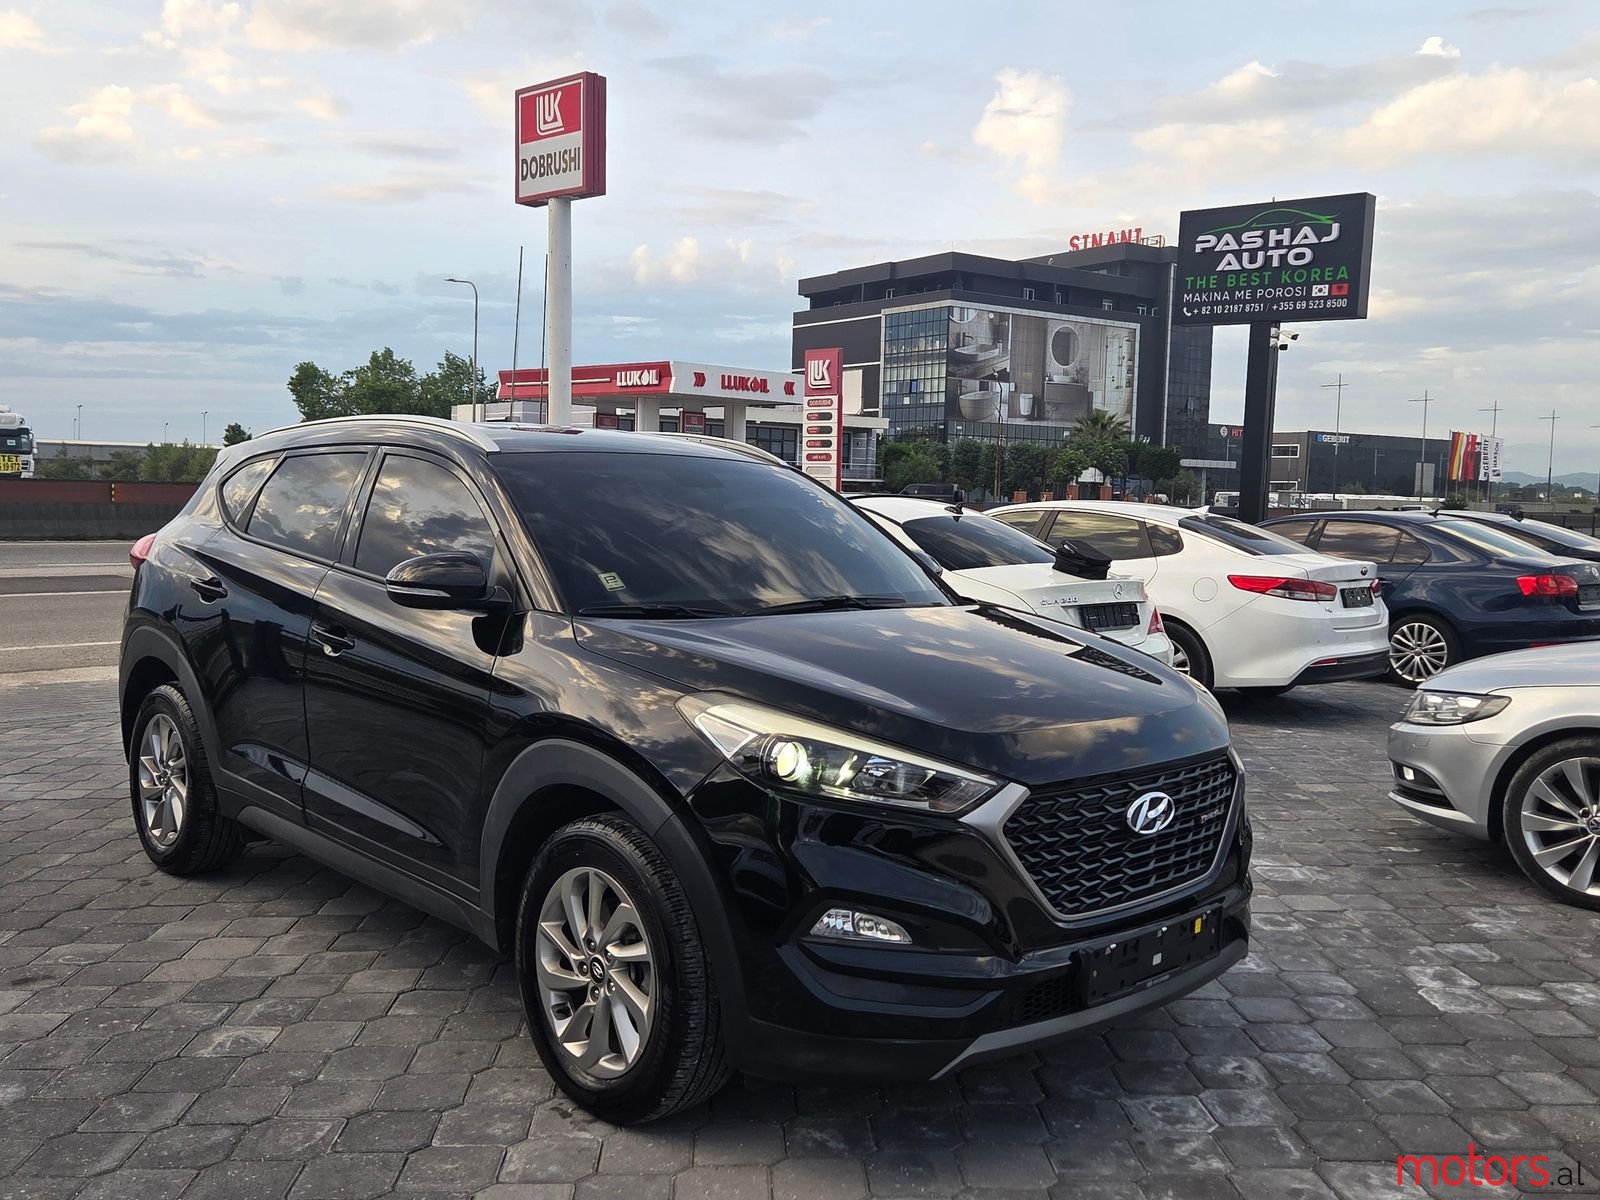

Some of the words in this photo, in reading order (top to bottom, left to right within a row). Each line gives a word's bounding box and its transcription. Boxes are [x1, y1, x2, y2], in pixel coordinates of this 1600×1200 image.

[521, 147, 580, 181] DOBRUSHI
[1195, 222, 1341, 253] PASHAJ
[1216, 247, 1314, 271] AUTO
[1185, 275, 1218, 289] THE
[1227, 271, 1272, 287] BEST
[1281, 266, 1349, 284] KOREA
[1183, 288, 1230, 303] MAKINA
[1235, 289, 1252, 300] ME
[1256, 286, 1307, 299] POROSI
[1213, 305, 1222, 314] 10
[1245, 302, 1264, 313] 8751
[1272, 300, 1294, 311] +355
[1296, 300, 1307, 310] 69
[1308, 299, 1325, 309] 523
[1326, 298, 1348, 308] 8500
[616, 369, 659, 386] LLUKOIL
[721, 374, 769, 393] LLUKOIL
